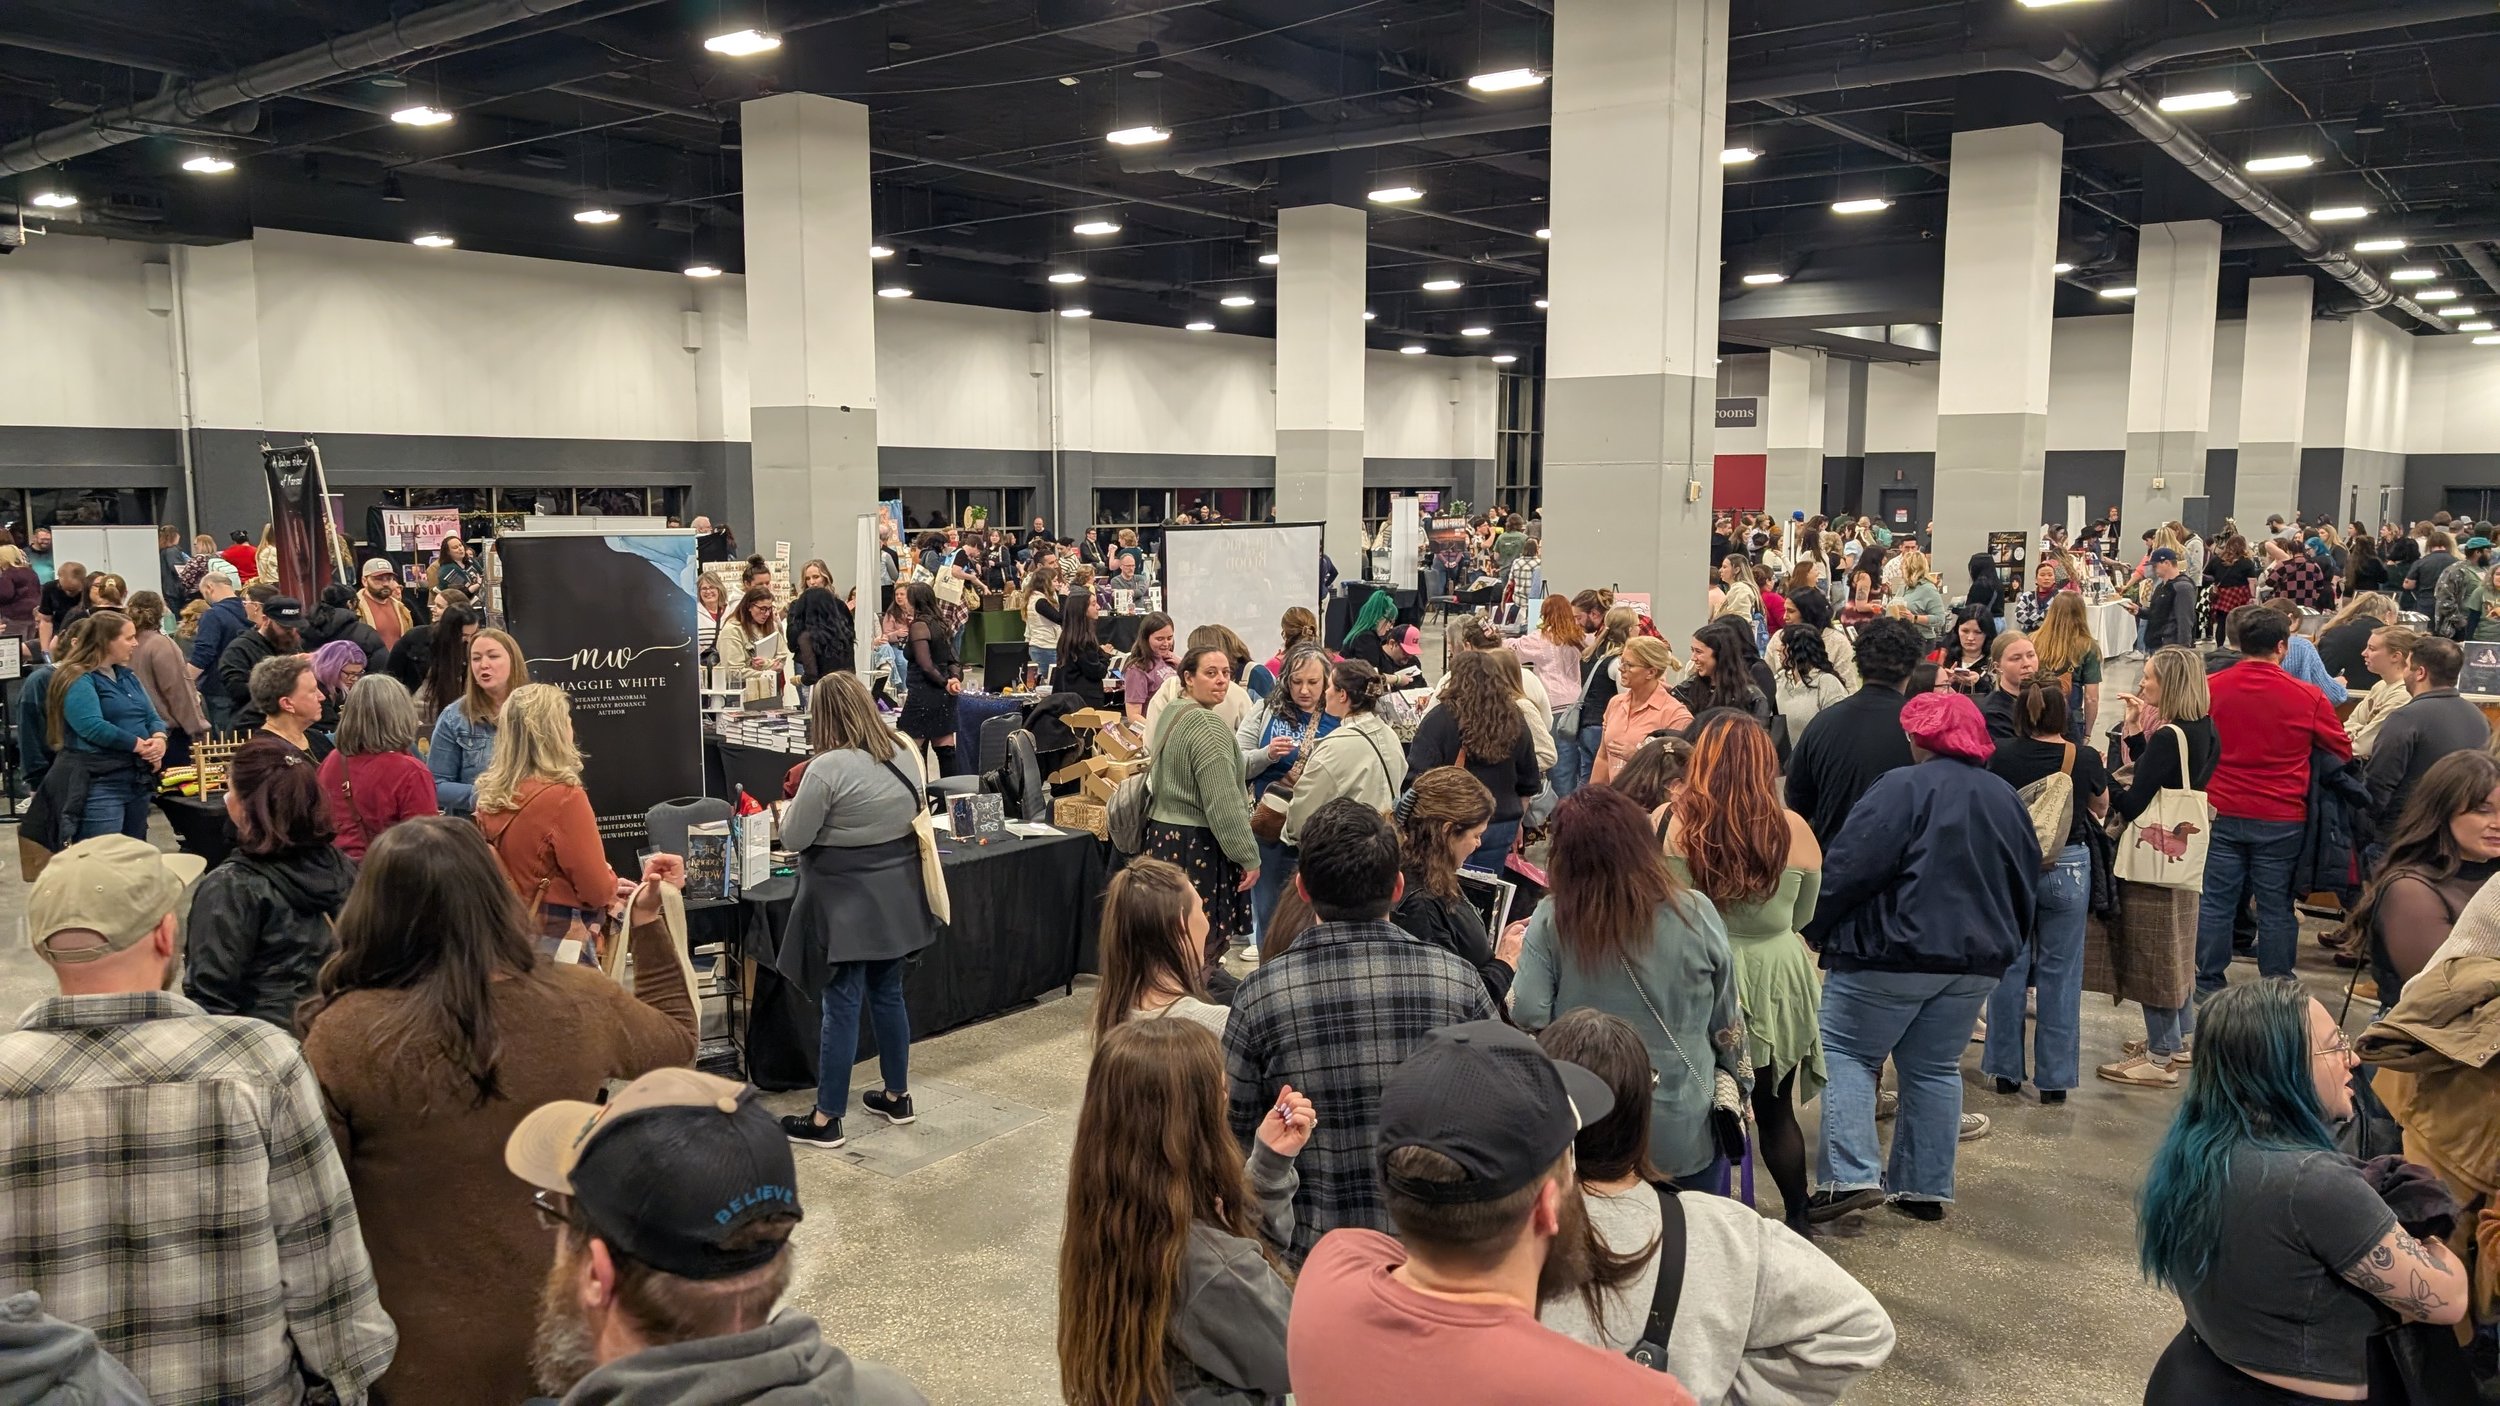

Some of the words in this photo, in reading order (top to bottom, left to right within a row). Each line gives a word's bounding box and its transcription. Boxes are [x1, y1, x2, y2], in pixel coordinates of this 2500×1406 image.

[390, 524, 440, 536] DAVIDSON
[554, 679, 613, 691] MAGGIE
[618, 676, 666, 688] WHITE
[603, 694, 648, 702] PARANORMAL
[1271, 726, 1306, 739] NEEDS
[598, 822, 646, 830] WHITEBOOKS.C
[714, 1184, 793, 1224] BELIEVE
